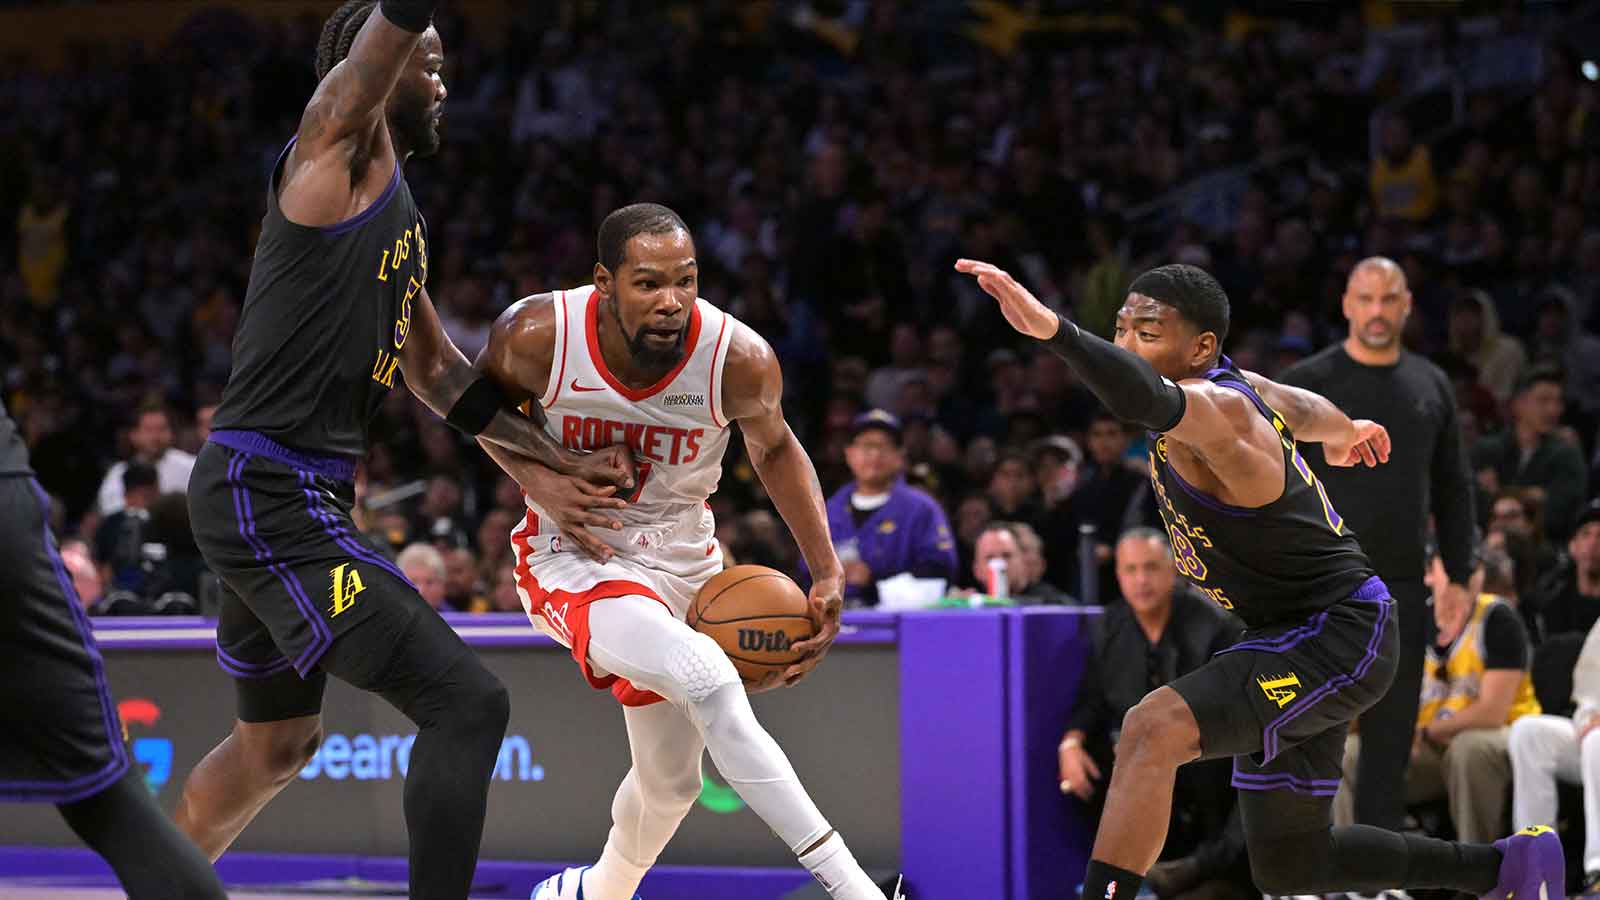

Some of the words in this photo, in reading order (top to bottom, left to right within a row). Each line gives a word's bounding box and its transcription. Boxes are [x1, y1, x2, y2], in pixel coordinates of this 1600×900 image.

[377, 229, 412, 281] LOS
[394, 275, 422, 350] 5
[663, 393, 705, 401] MEMORIAL
[562, 415, 705, 466] ROCKETS
[327, 562, 368, 618] LA
[299, 733, 418, 781] ear
